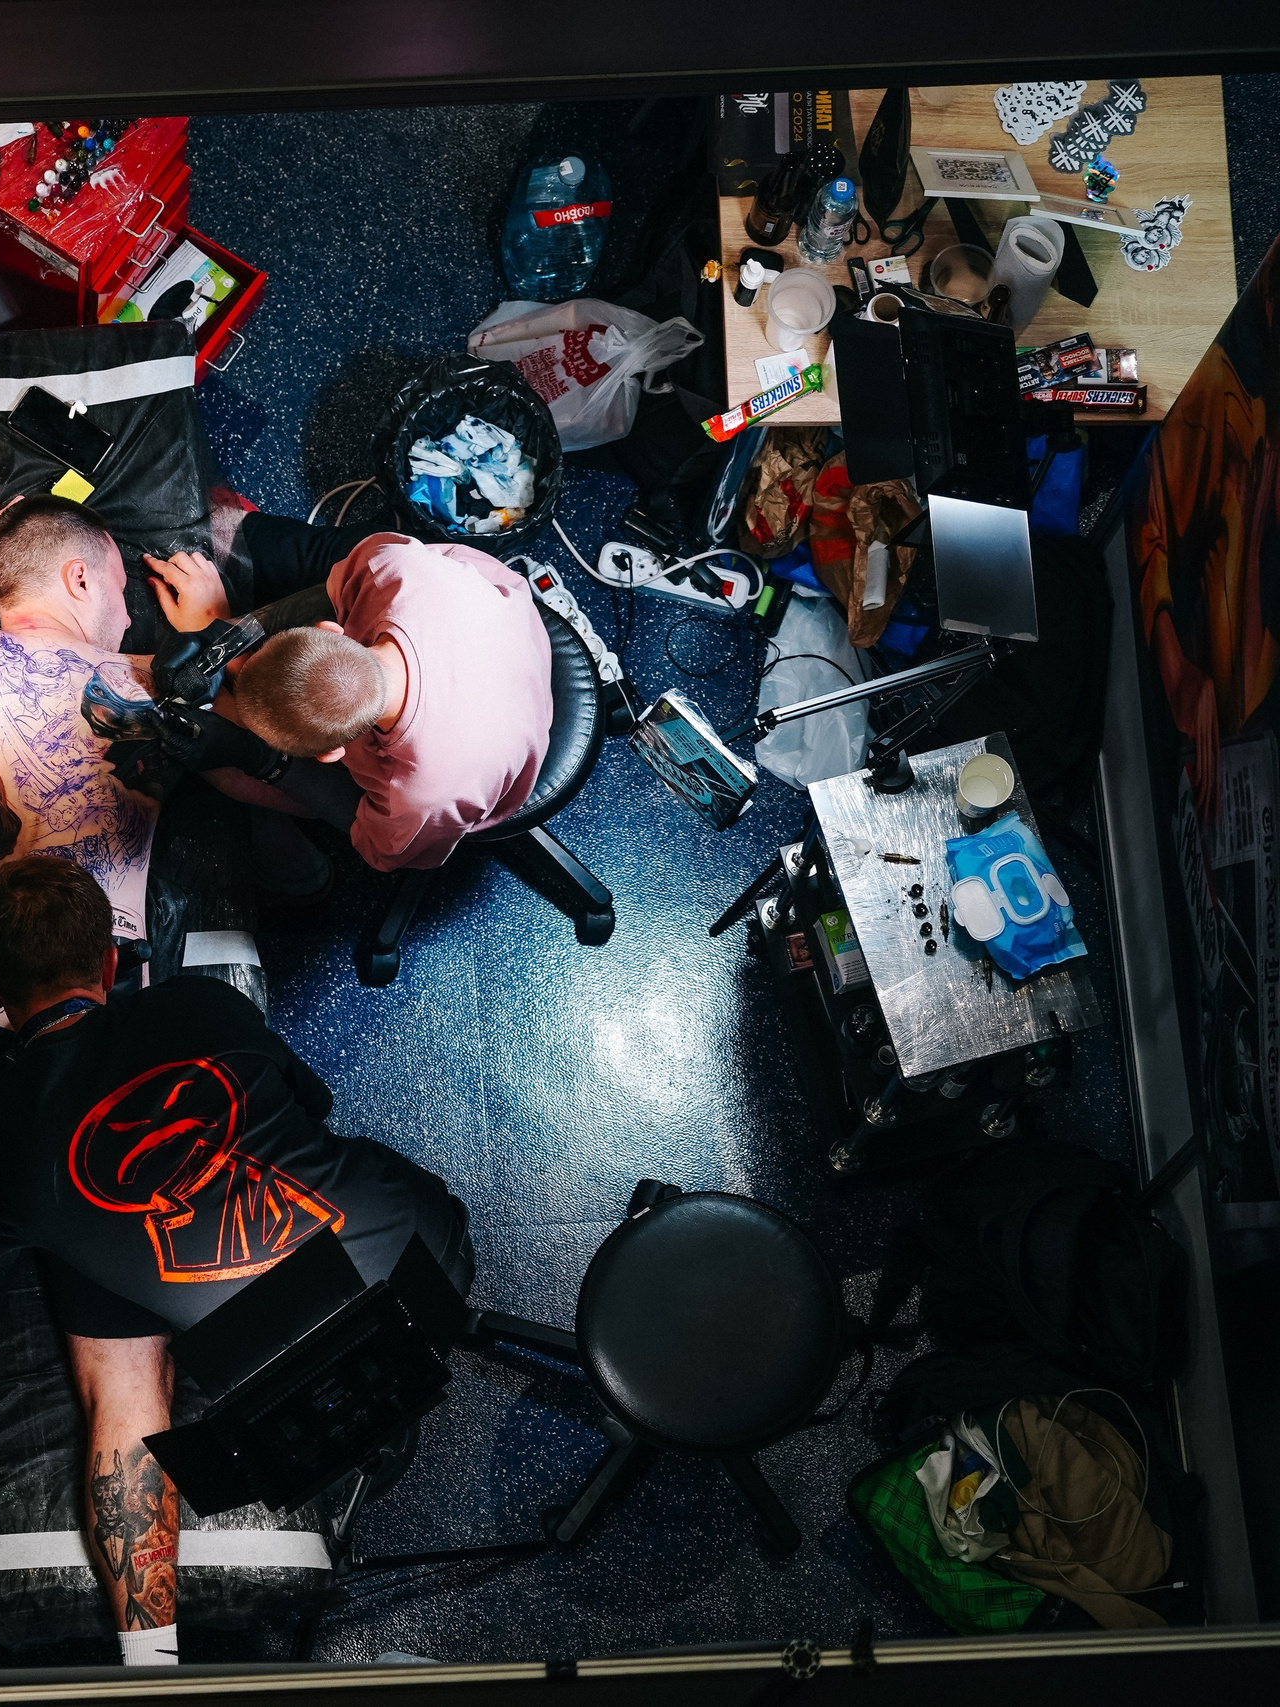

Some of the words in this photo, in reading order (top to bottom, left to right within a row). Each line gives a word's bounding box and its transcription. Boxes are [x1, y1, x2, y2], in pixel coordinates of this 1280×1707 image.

[793, 107, 803, 142] 2024
[748, 375, 804, 415] SNICKERS
[1056, 391, 1085, 401] SUPER
[1084, 391, 1135, 404] SNICKERS
[695, 737, 716, 762] The
[1263, 806, 1274, 872] The
[117, 915, 137, 932] Times
[1264, 876, 1276, 950] New
[1262, 957, 1280, 1039] York
[134, 1553, 149, 1571] ACE
